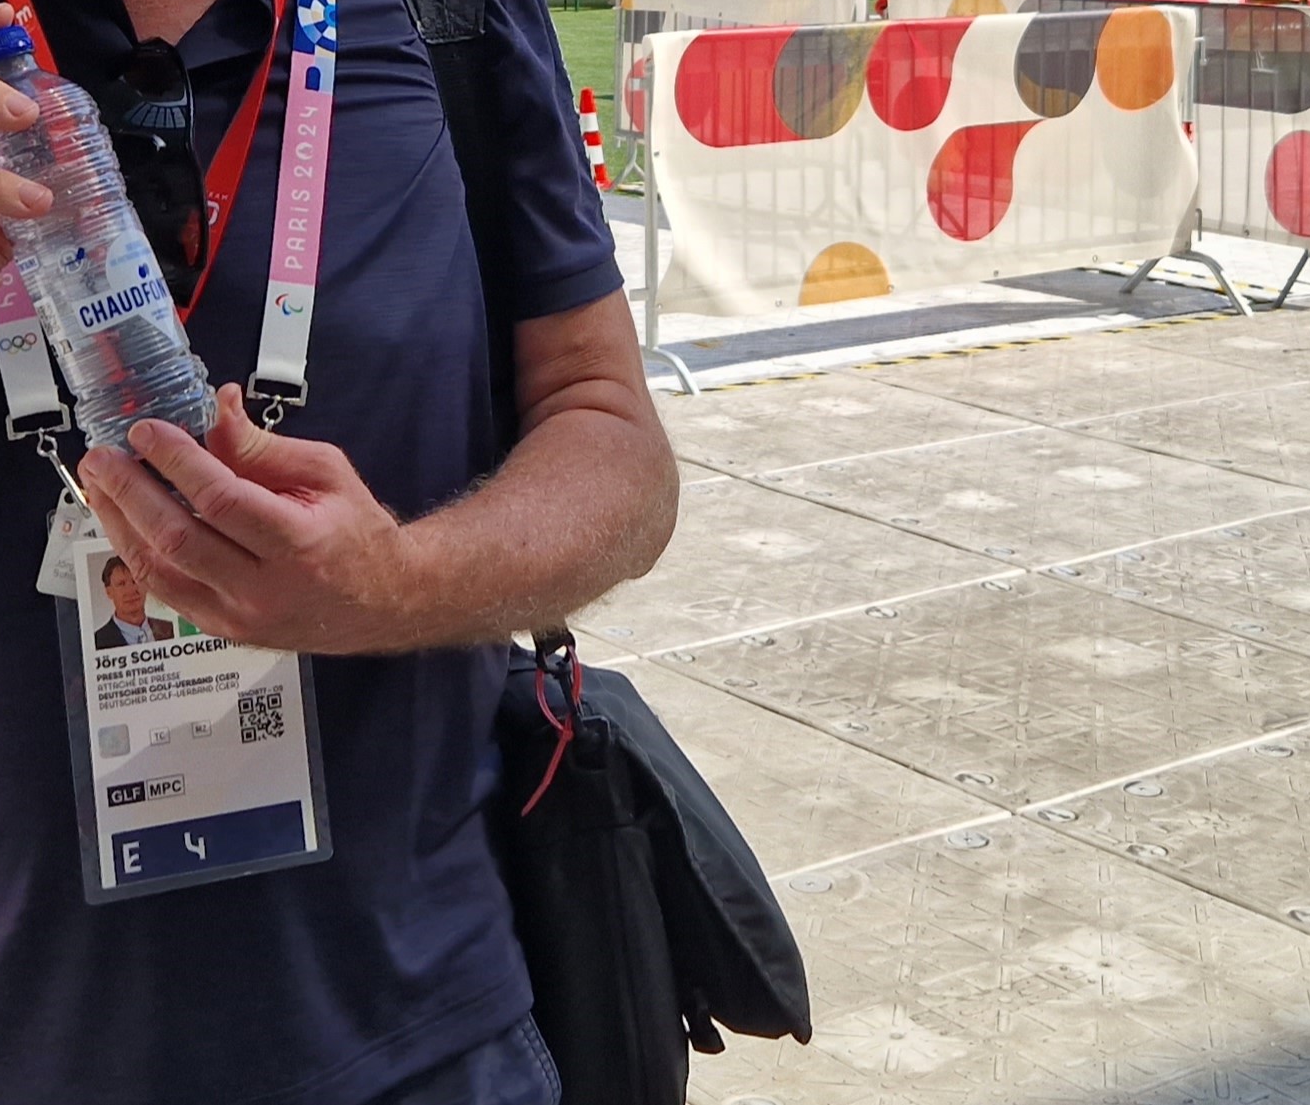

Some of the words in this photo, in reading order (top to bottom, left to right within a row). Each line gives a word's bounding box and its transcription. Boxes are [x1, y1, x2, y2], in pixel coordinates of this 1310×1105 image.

[294, 105, 319, 178] 2024
[284, 188, 311, 269] PARIS
[95, 654, 127, 670] Jörg
[96, 670, 124, 682] PRESS
[125, 662, 165, 678] ATTACHÉ
[97, 678, 136, 692] ATTACHÉ
[138, 676, 148, 685] DE
[150, 671, 181, 684] PRESSE
[98, 687, 147, 701] DEUTSCHER
[149, 676, 214, 693] GOLF-VERBAND
[215, 671, 240, 683] (GER)
[99, 696, 148, 711] DEUTSCHER
[215, 680, 240, 693] (GER)
[111, 786, 141, 804] GLF
[149, 779, 182, 797] MPC
[122, 841, 141, 874] E
[184, 831, 206, 860] 4
